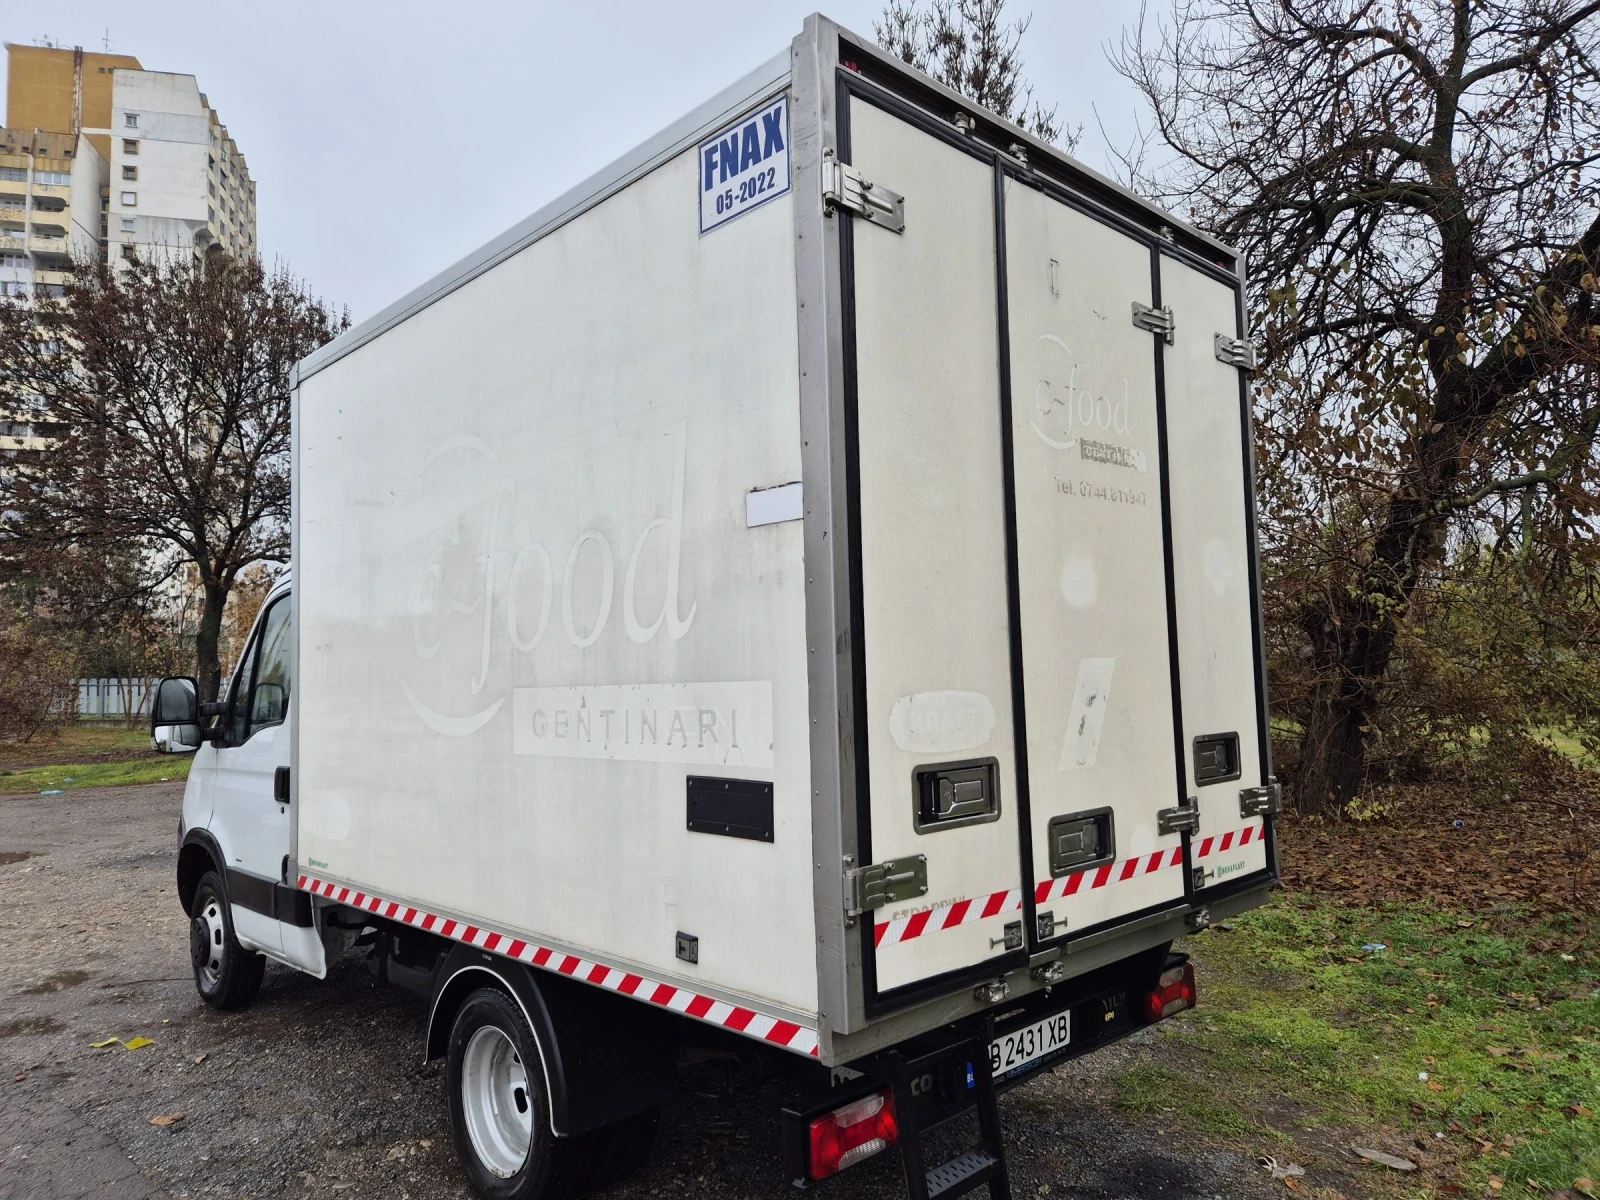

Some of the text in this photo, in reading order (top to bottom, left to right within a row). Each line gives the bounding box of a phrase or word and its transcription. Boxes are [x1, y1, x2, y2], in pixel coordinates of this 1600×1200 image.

[704, 106, 785, 193] FNAX
[715, 166, 776, 215] 05-2022
[1005, 1024, 1043, 1067] 2431
[1047, 1015, 1068, 1048] XB
